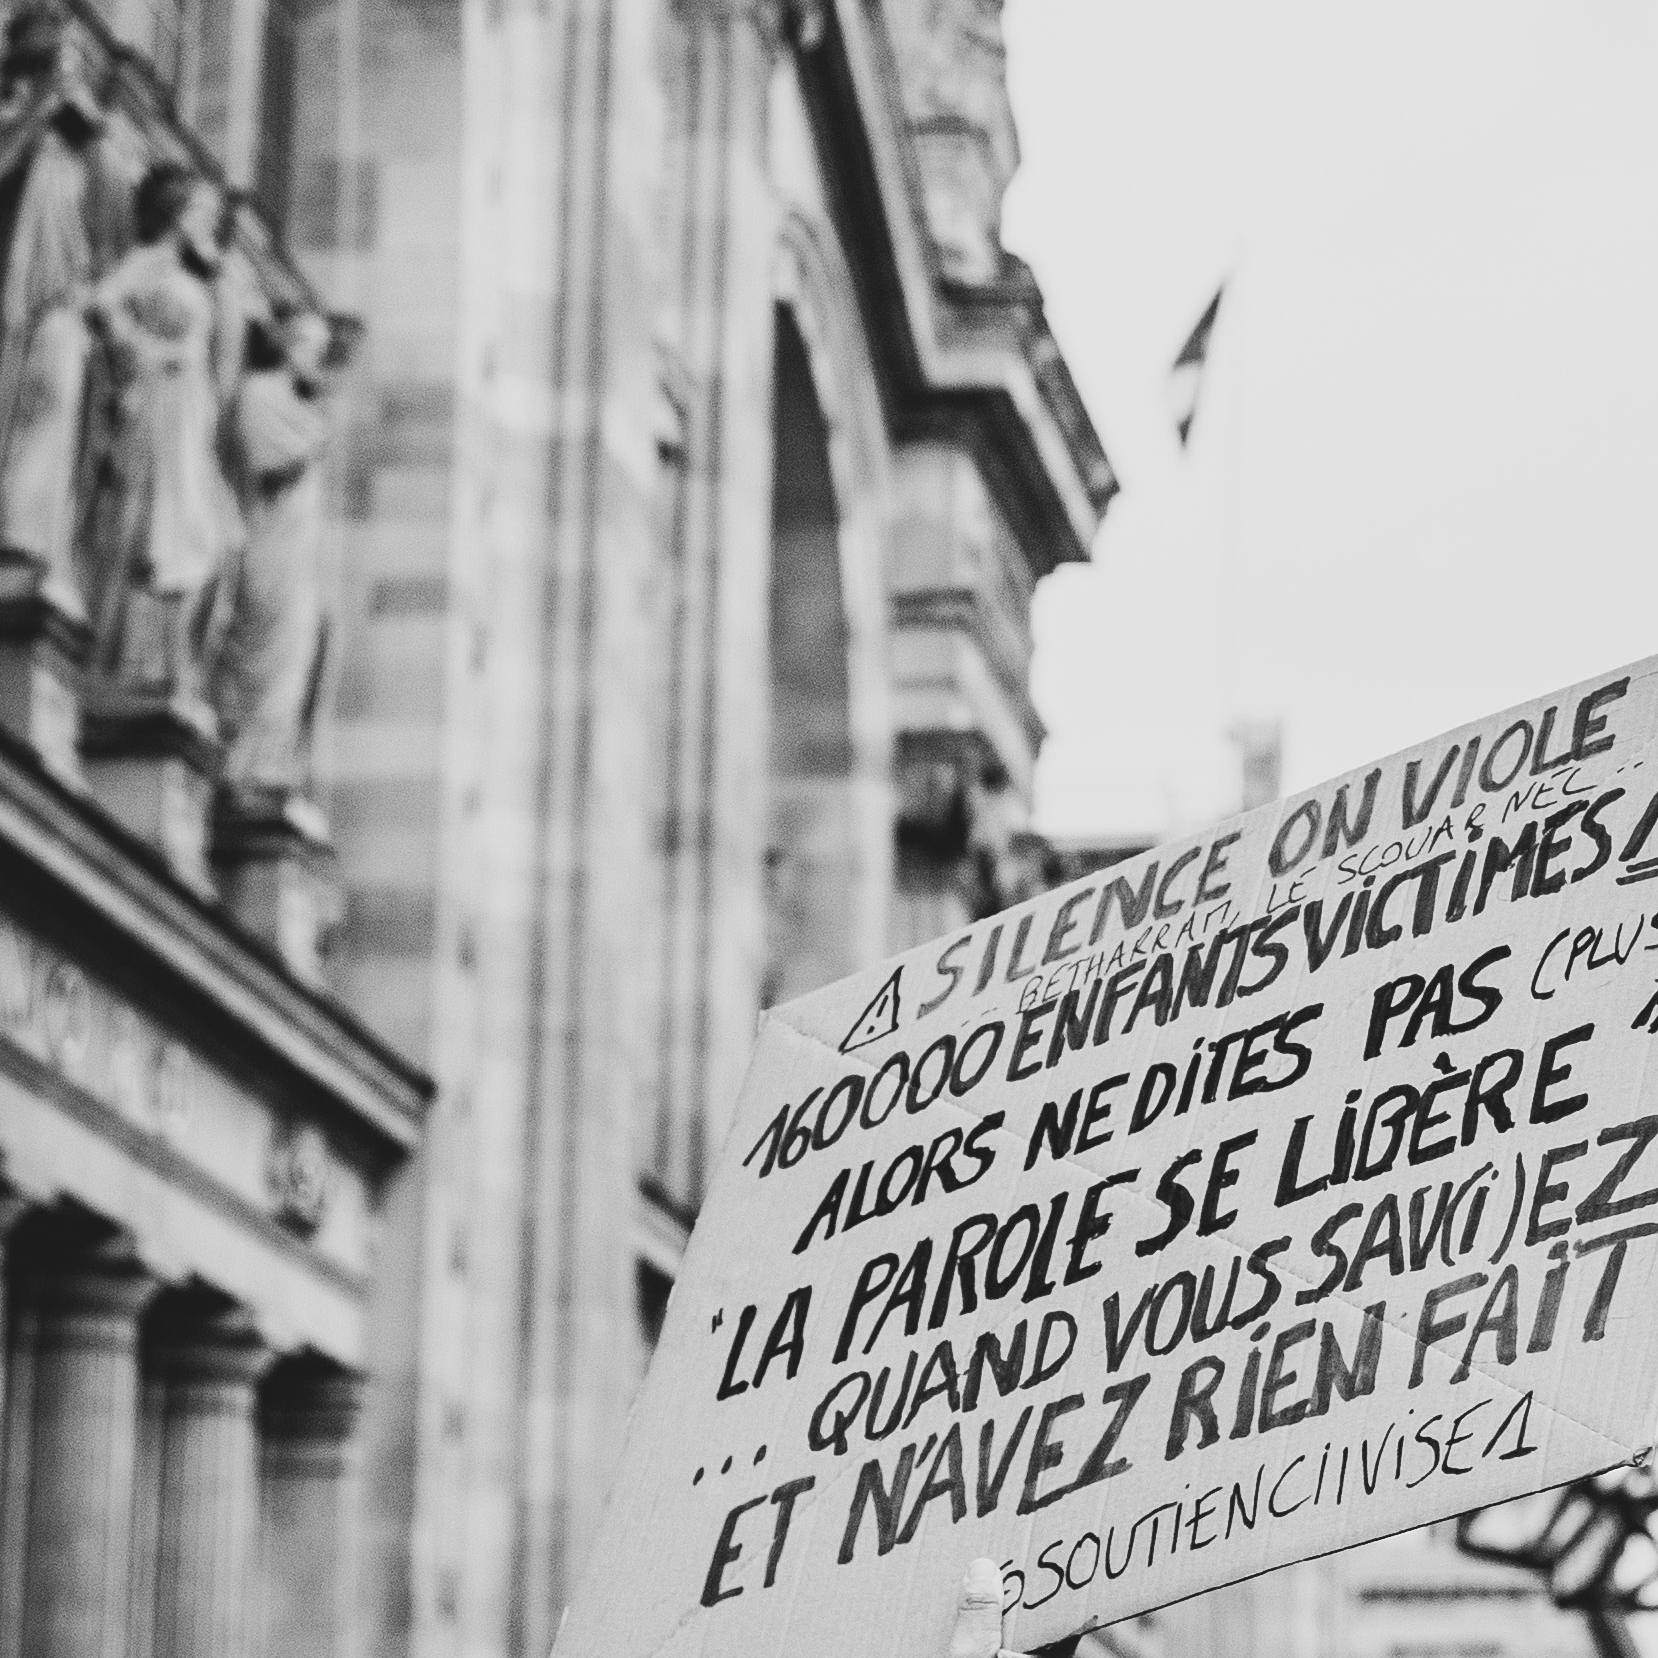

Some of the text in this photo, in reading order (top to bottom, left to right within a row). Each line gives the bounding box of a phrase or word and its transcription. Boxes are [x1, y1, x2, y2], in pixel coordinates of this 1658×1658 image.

[917, 677, 1631, 1019] SILENCE ON VIOLE
[743, 1021, 1005, 1178] 160000
[1006, 899, 1302, 1083] ENFANTS
[793, 1110, 1005, 1254] ALORS
[1024, 1072, 1130, 1171] NE
[1363, 944, 1512, 1062] PAS
[832, 1168, 1140, 1364] PAROLE
[1135, 1128, 1258, 1257] SE
[1103, 1236, 1292, 1372] VOUS
[700, 1475, 816, 1607] ET
[838, 1373, 1151, 1565] N'AVEZ
